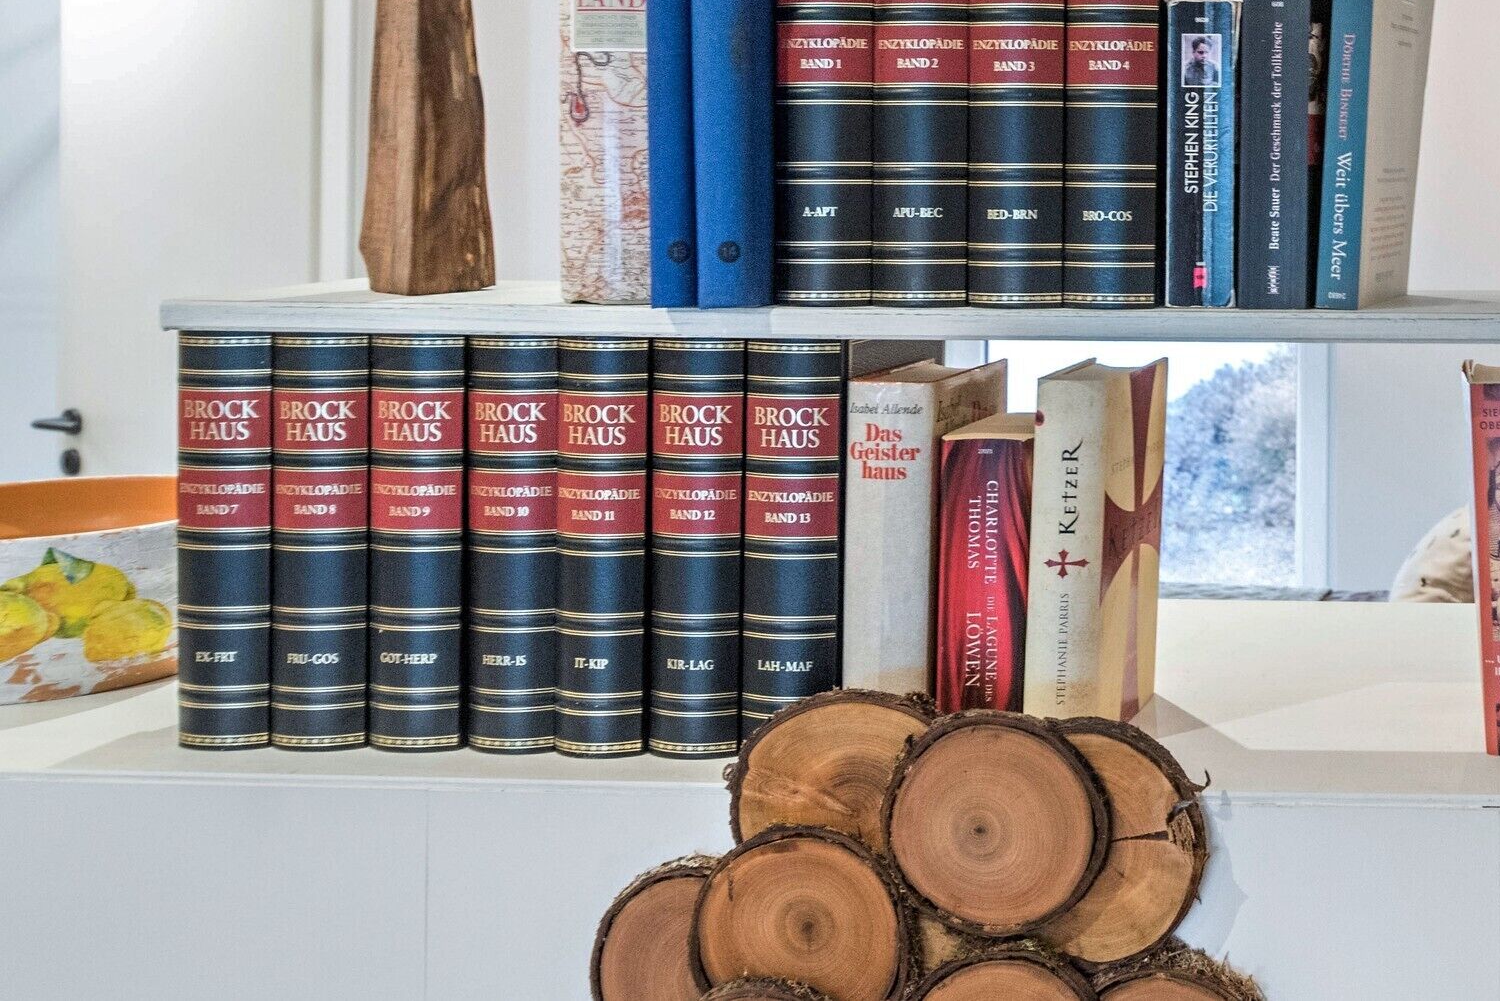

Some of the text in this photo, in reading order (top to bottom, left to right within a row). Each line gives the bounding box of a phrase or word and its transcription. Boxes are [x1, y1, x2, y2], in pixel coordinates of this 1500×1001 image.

[1271, 21, 1283, 78] Tollkirsche
[1271, 81, 1282, 98] der
[1270, 101, 1282, 161] Geschmack
[1185, 92, 1199, 194] STEPHEN KING
[1203, 91, 1219, 212] DIE VERURTEILTEN
[1270, 163, 1280, 182] Der
[1335, 152, 1352, 186] Weit
[1269, 188, 1280, 213] Sauer
[1083, 210, 1132, 221] BRO-COS
[1333, 190, 1350, 235] übers
[1269, 215, 1279, 249] Beate
[1328, 239, 1348, 281] Meer
[184, 400, 259, 419] BROCK
[755, 406, 830, 427] BROCK
[849, 402, 923, 415] Isabel Allende
[190, 421, 250, 441] HAUS
[761, 428, 819, 449] HAUS
[865, 423, 902, 442] Das
[850, 442, 921, 462] Geister
[861, 461, 907, 480] haus
[749, 491, 833, 502] ENZYKLOPÄDIE
[765, 512, 810, 523] BAND 13
[967, 495, 981, 570] THOMAS
[985, 480, 998, 585] CHARLOTTE
[965, 611, 981, 687] LÖWEN
[984, 611, 998, 681] LAGUNE
[1056, 593, 1070, 706] STEPHANIE PARRIS
[758, 659, 813, 672] LAH-MAF
